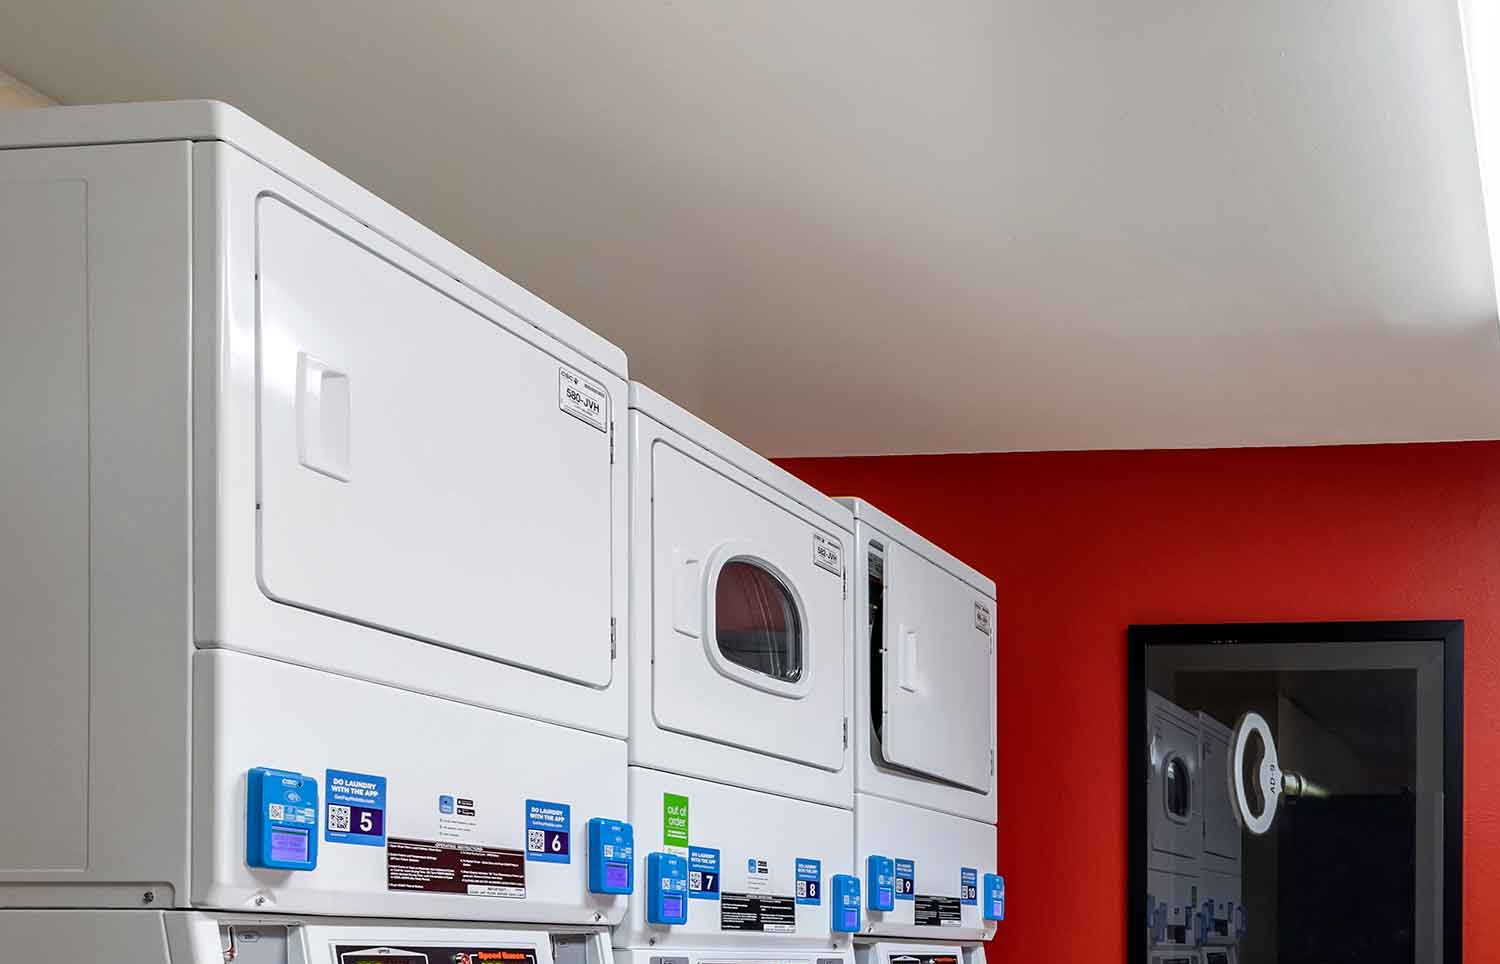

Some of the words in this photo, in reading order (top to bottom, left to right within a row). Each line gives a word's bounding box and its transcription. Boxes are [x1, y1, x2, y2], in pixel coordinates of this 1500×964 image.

[566, 388, 600, 413] 580-JVH
[360, 812, 372, 831] 5
[552, 834, 561, 852] 6
[706, 875, 714, 890] 7
[809, 883, 816, 897] 8
[905, 881, 911, 892] 9
[968, 888, 975, 898] 10
